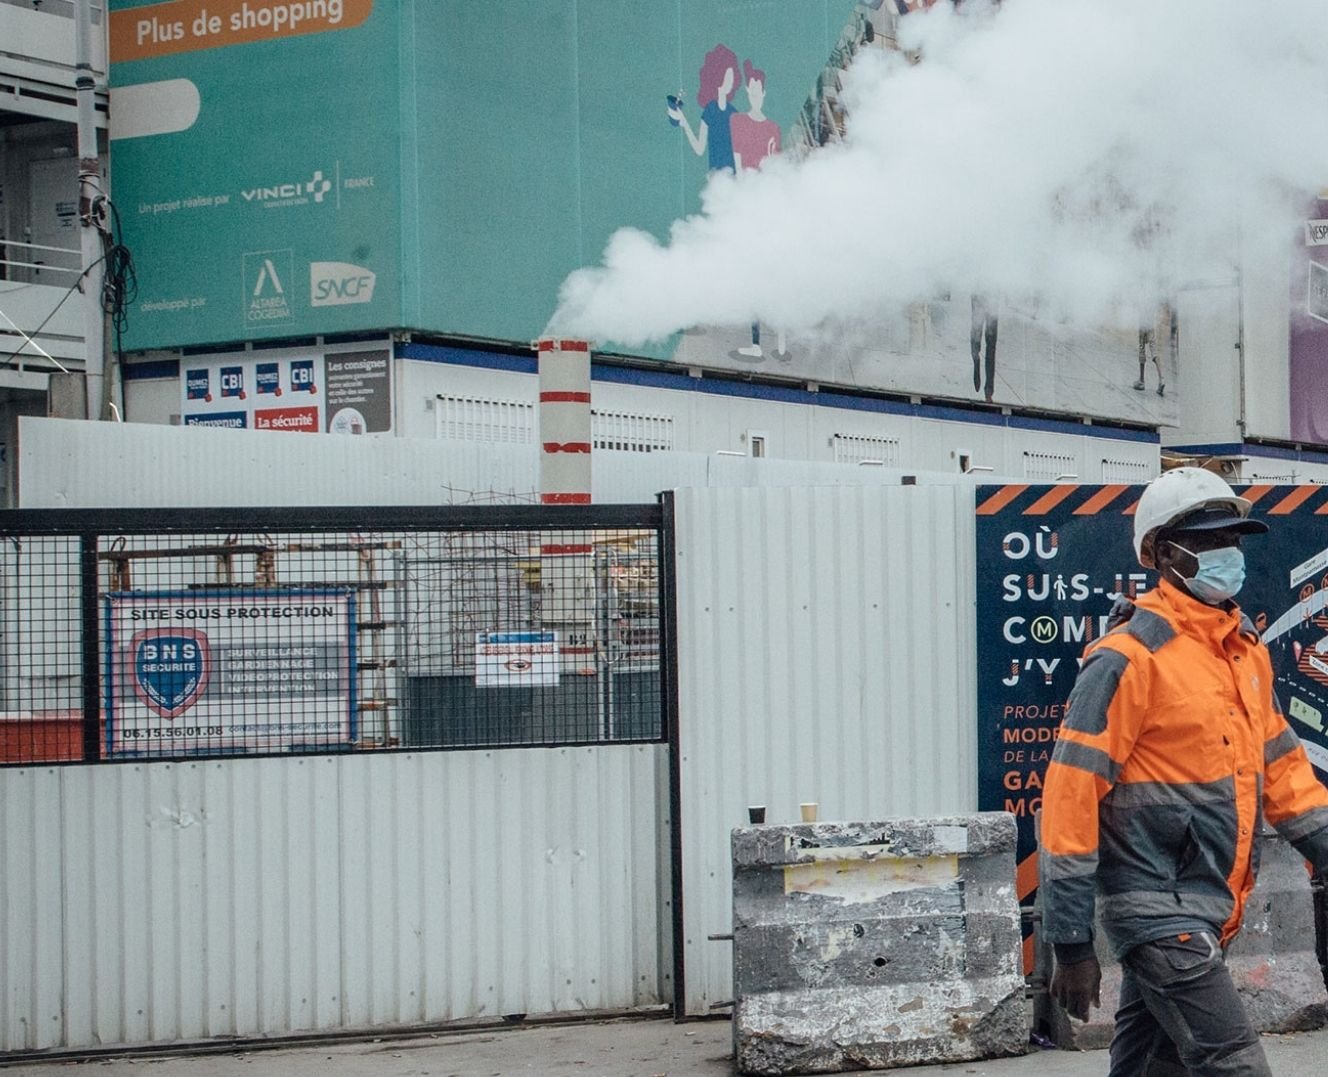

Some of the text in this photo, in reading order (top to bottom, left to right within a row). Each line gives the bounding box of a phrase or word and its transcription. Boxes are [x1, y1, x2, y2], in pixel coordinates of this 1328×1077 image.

[136, 0, 343, 45] Plus de shopping
[241, 183, 302, 202] VINCI
[138, 202, 152, 214] Un
[153, 199, 181, 216] projet
[314, 275, 371, 300] SNCF
[247, 307, 290, 321] COGEDIM
[328, 359, 386, 371] Les consignes
[221, 373, 243, 390] CBI
[291, 367, 313, 384] CBI
[188, 416, 243, 428] Bienvenue
[257, 412, 314, 429] La sécurité
[1002, 525, 1059, 560] OÙ
[130, 606, 334, 621] SITE SOUS PROTECTION
[227, 647, 318, 658] SURVEILLANCE
[142, 663, 196, 673] SECURITE
[228, 659, 315, 670] GARDIENNAGE
[123, 725, 224, 739] 06.15.56.01.08
[1004, 750, 1049, 763] DE LA
